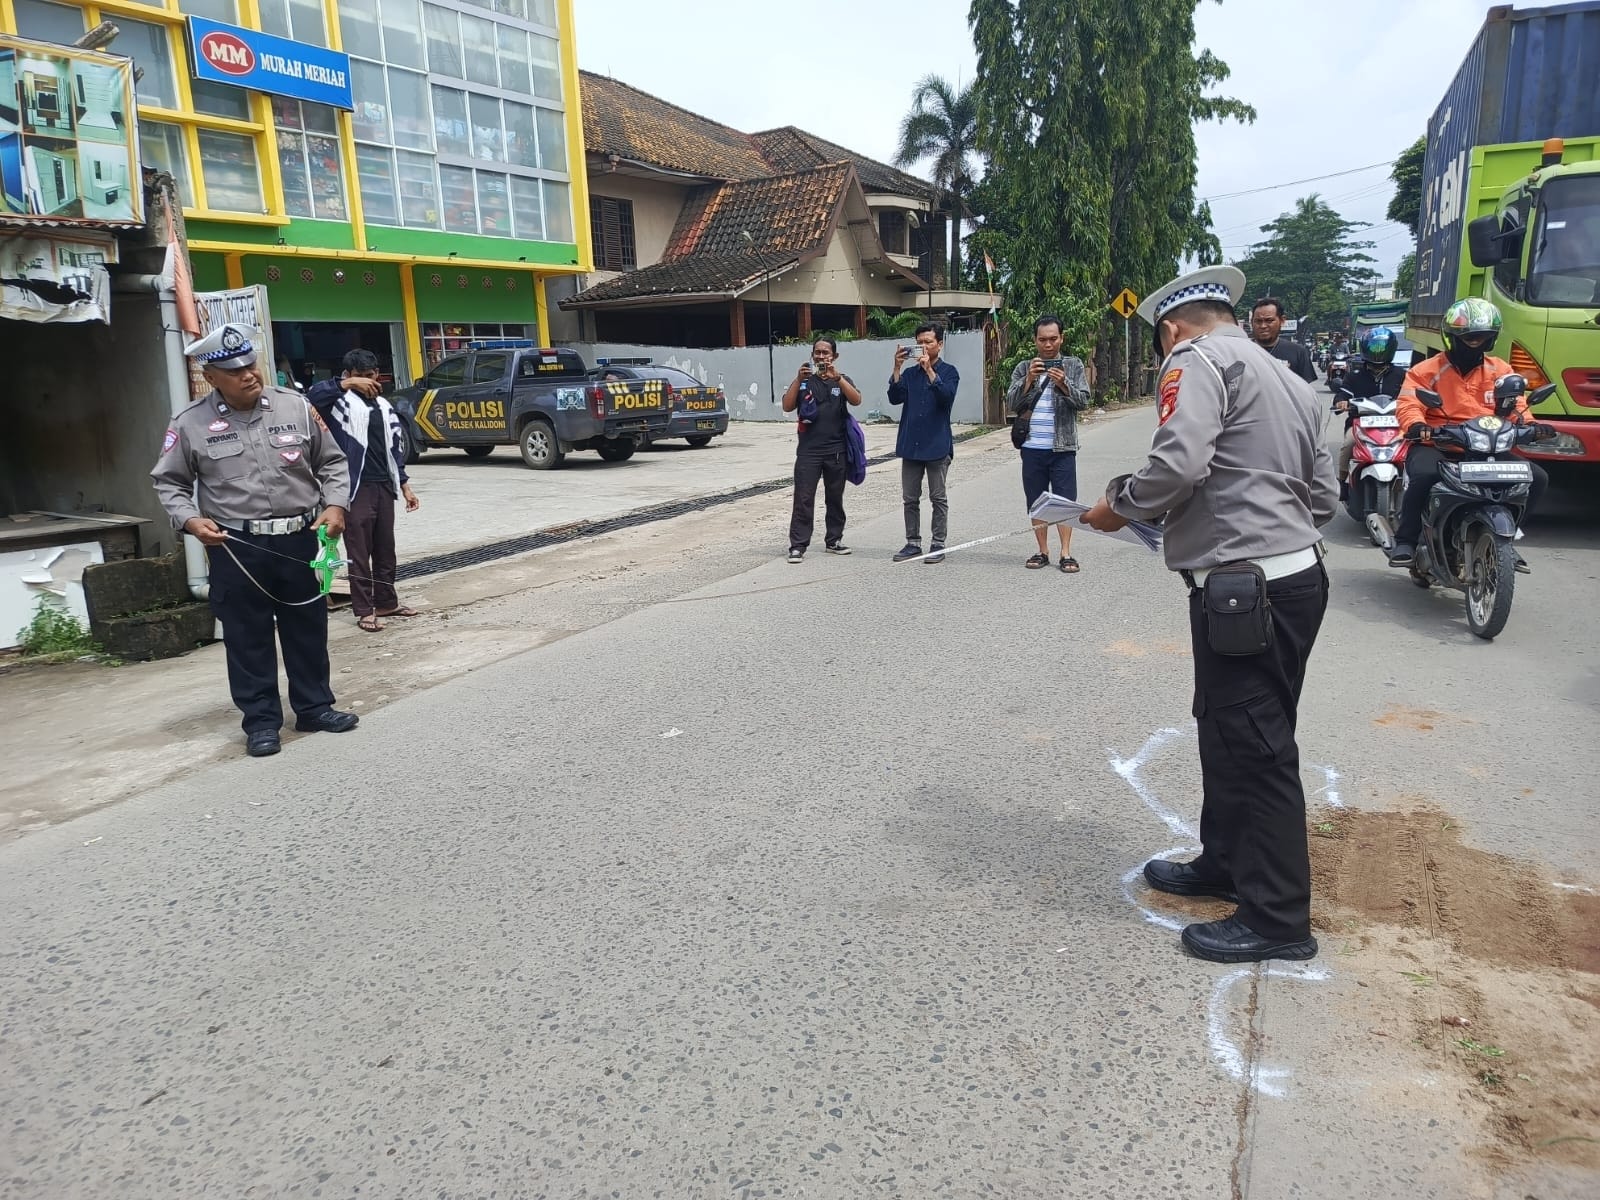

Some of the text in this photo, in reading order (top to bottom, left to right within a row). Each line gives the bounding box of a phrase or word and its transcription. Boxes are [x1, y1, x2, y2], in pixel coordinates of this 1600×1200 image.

[208, 40, 248, 67] MM
[260, 53, 346, 89] MURAH MERIAH
[446, 401, 504, 419] POLISI
[615, 393, 661, 410] POLISI
[686, 401, 716, 410] POLISI
[268, 424, 297, 434] POLRI
[449, 420, 506, 430] POLSEK KALIDONI
